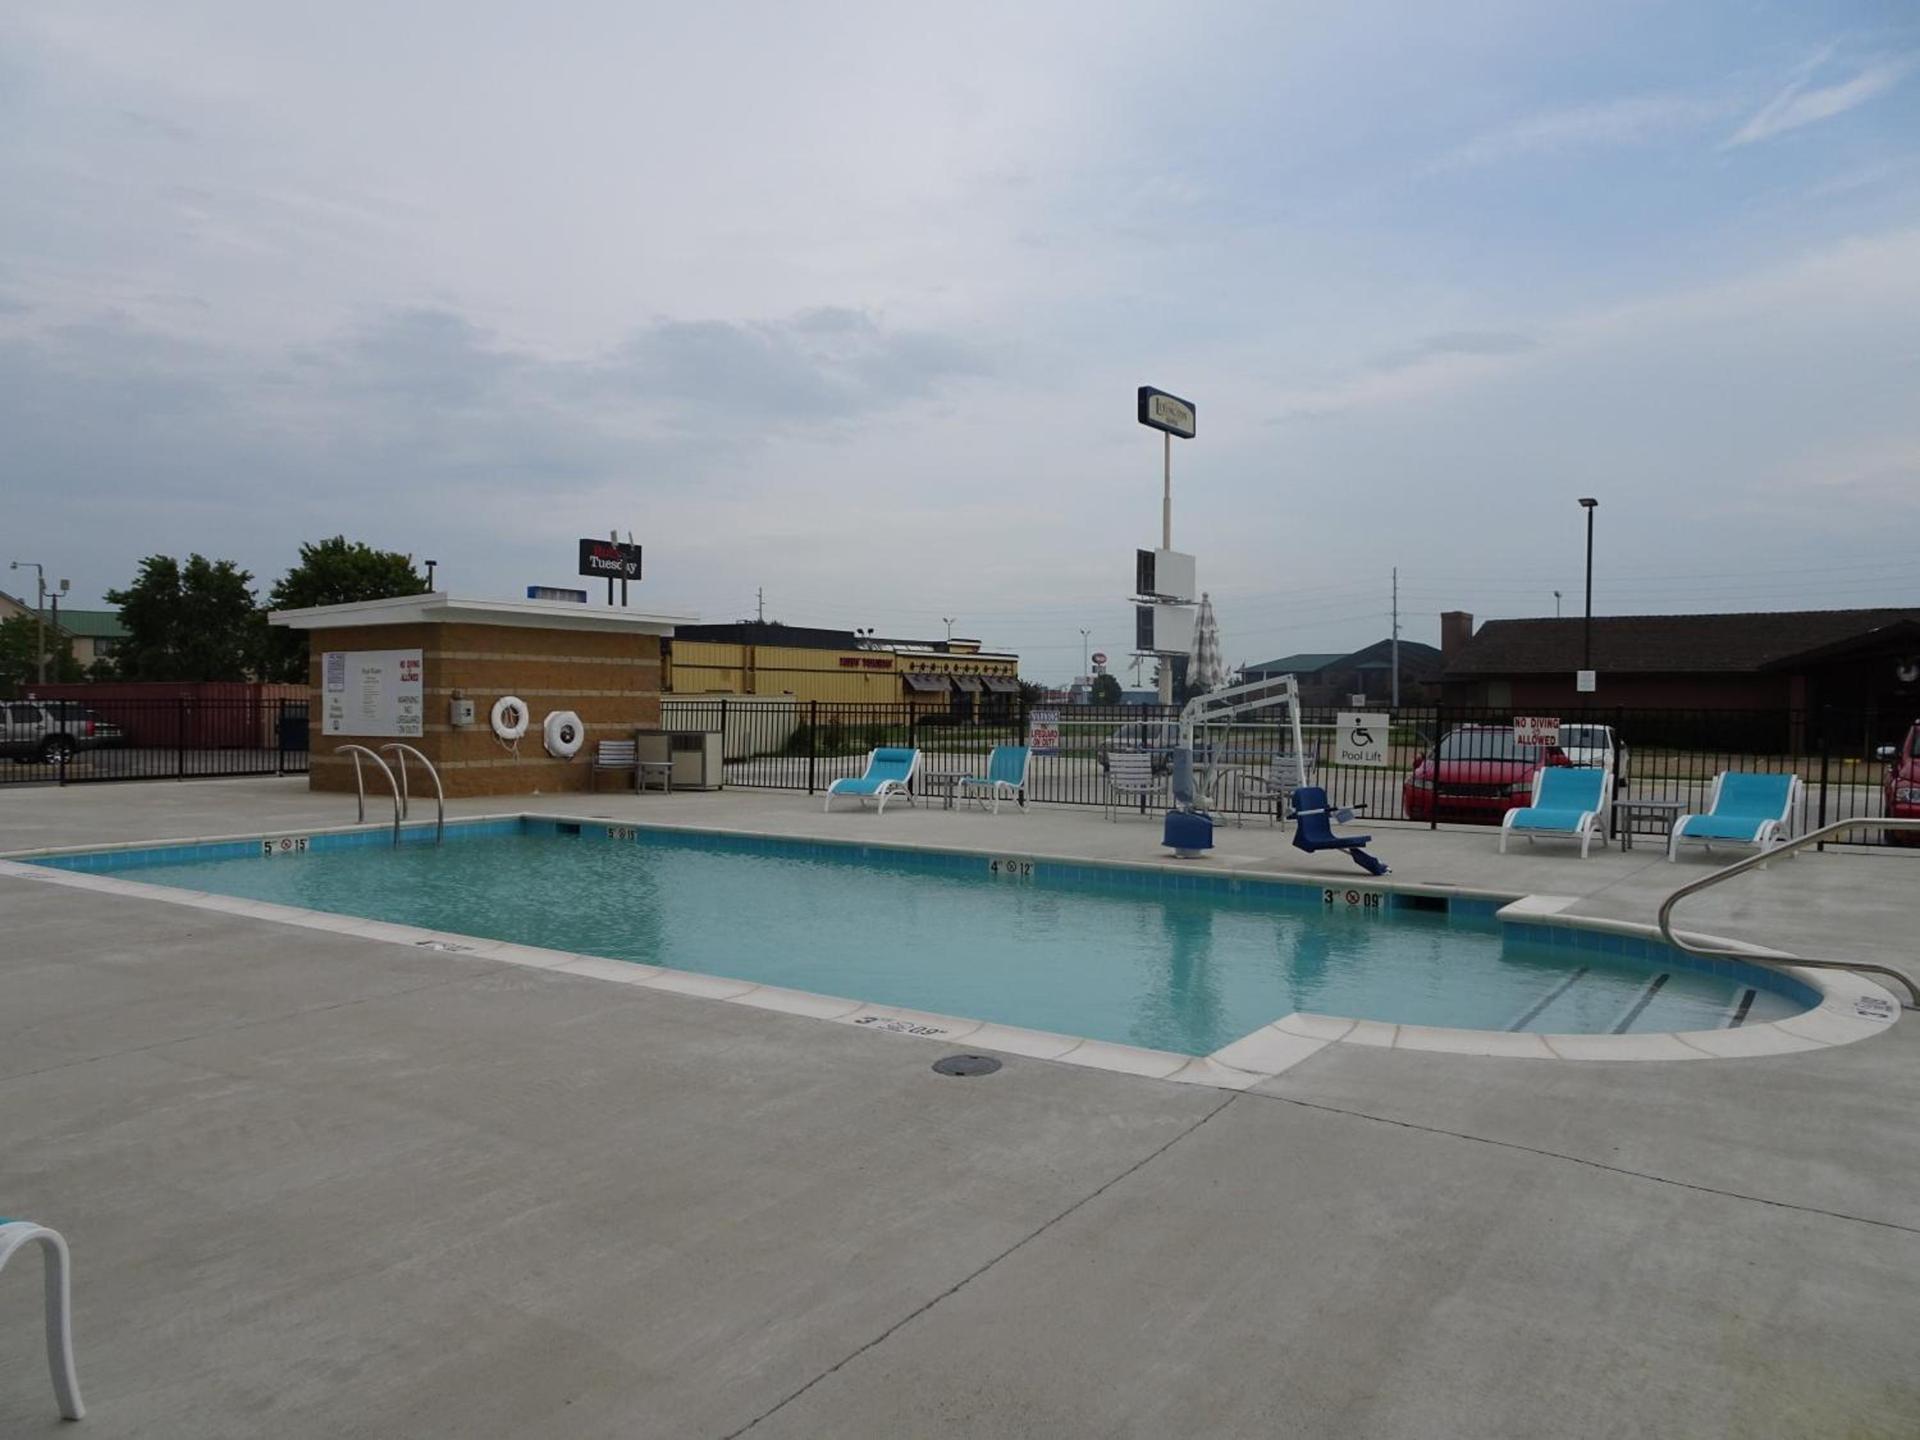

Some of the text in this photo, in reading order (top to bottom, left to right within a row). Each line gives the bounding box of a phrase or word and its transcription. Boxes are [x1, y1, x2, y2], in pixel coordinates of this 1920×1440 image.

[1514, 717, 1559, 729] NO DIVING
[1517, 735, 1556, 746] ALLOWED
[1342, 750, 1381, 762] Pool Lift
